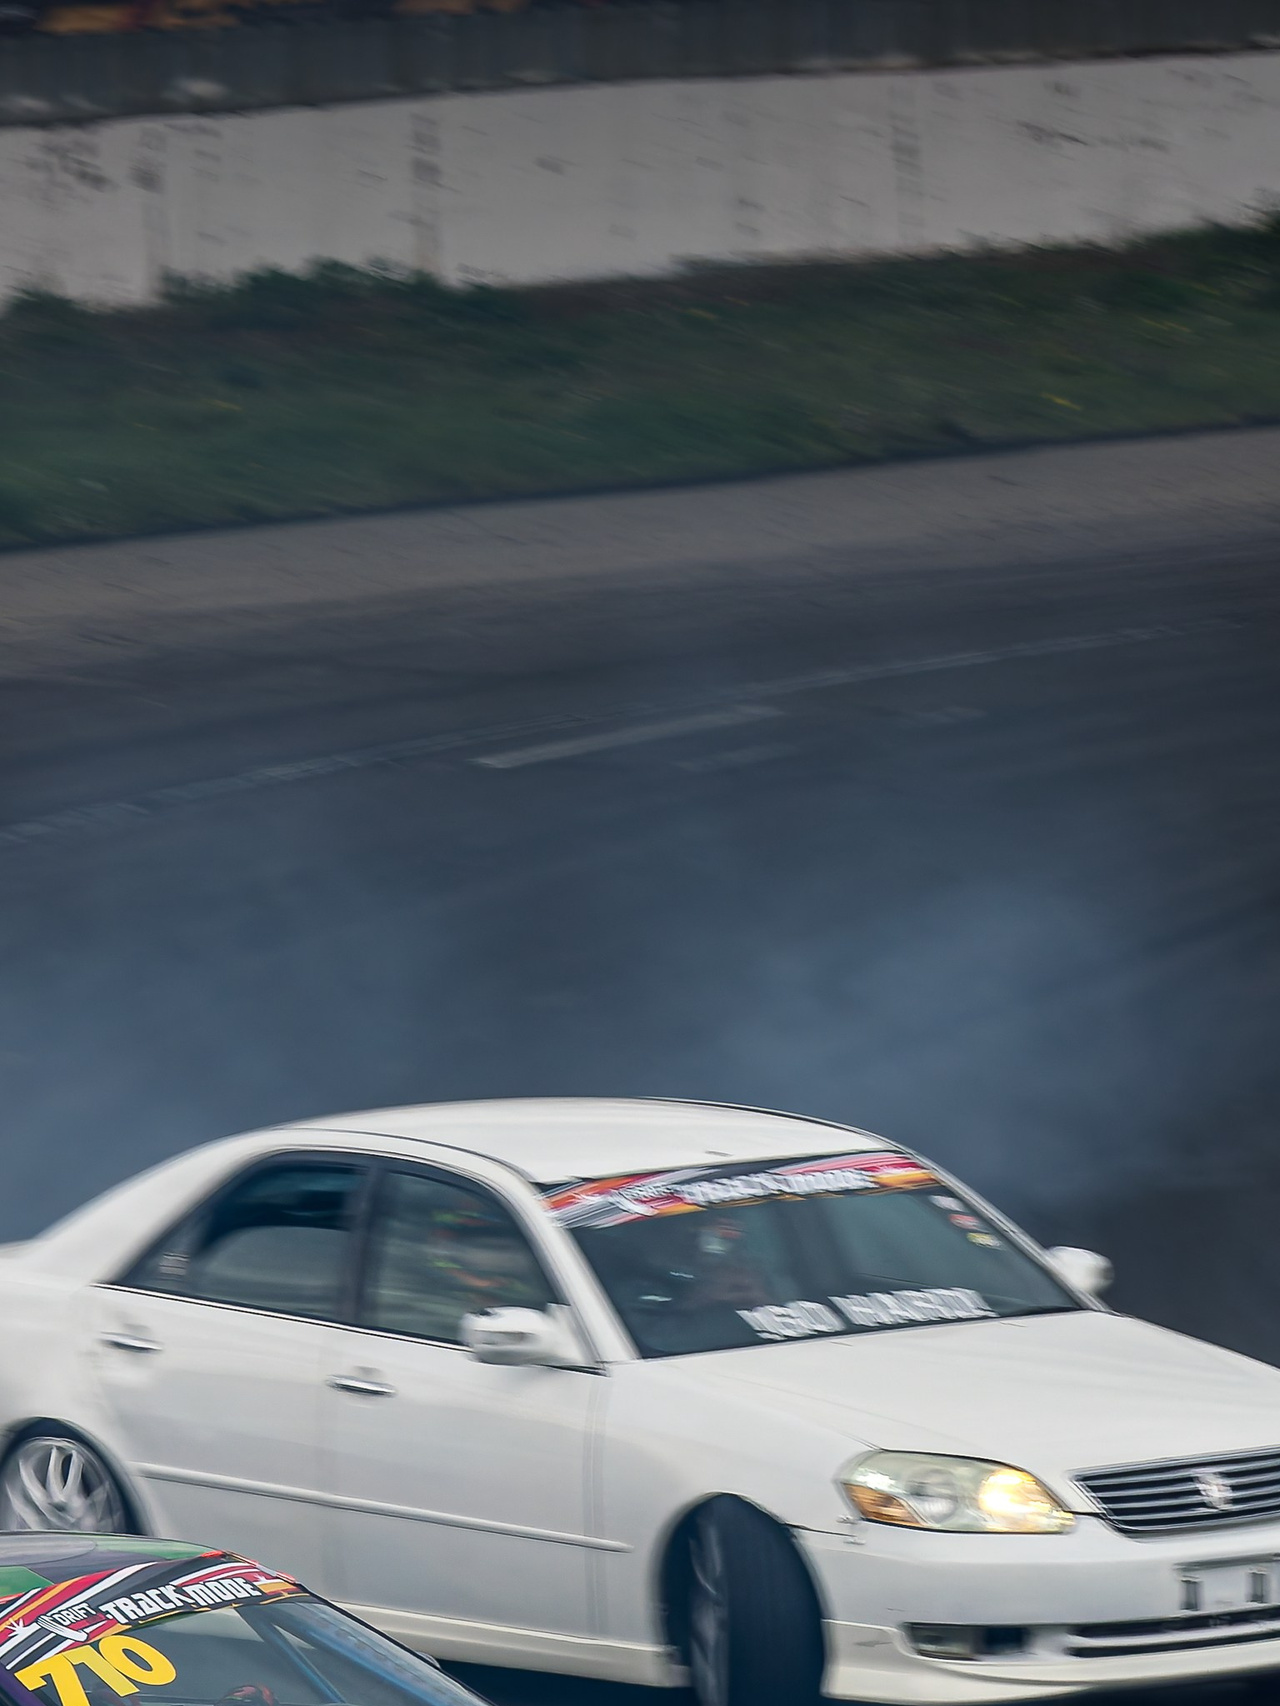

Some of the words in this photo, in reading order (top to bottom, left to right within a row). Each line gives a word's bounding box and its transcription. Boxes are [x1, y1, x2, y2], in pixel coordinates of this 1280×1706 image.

[54, 1603, 98, 1627] DRIFT
[99, 1585, 188, 1625] TRACK
[183, 1577, 262, 1606] MODE
